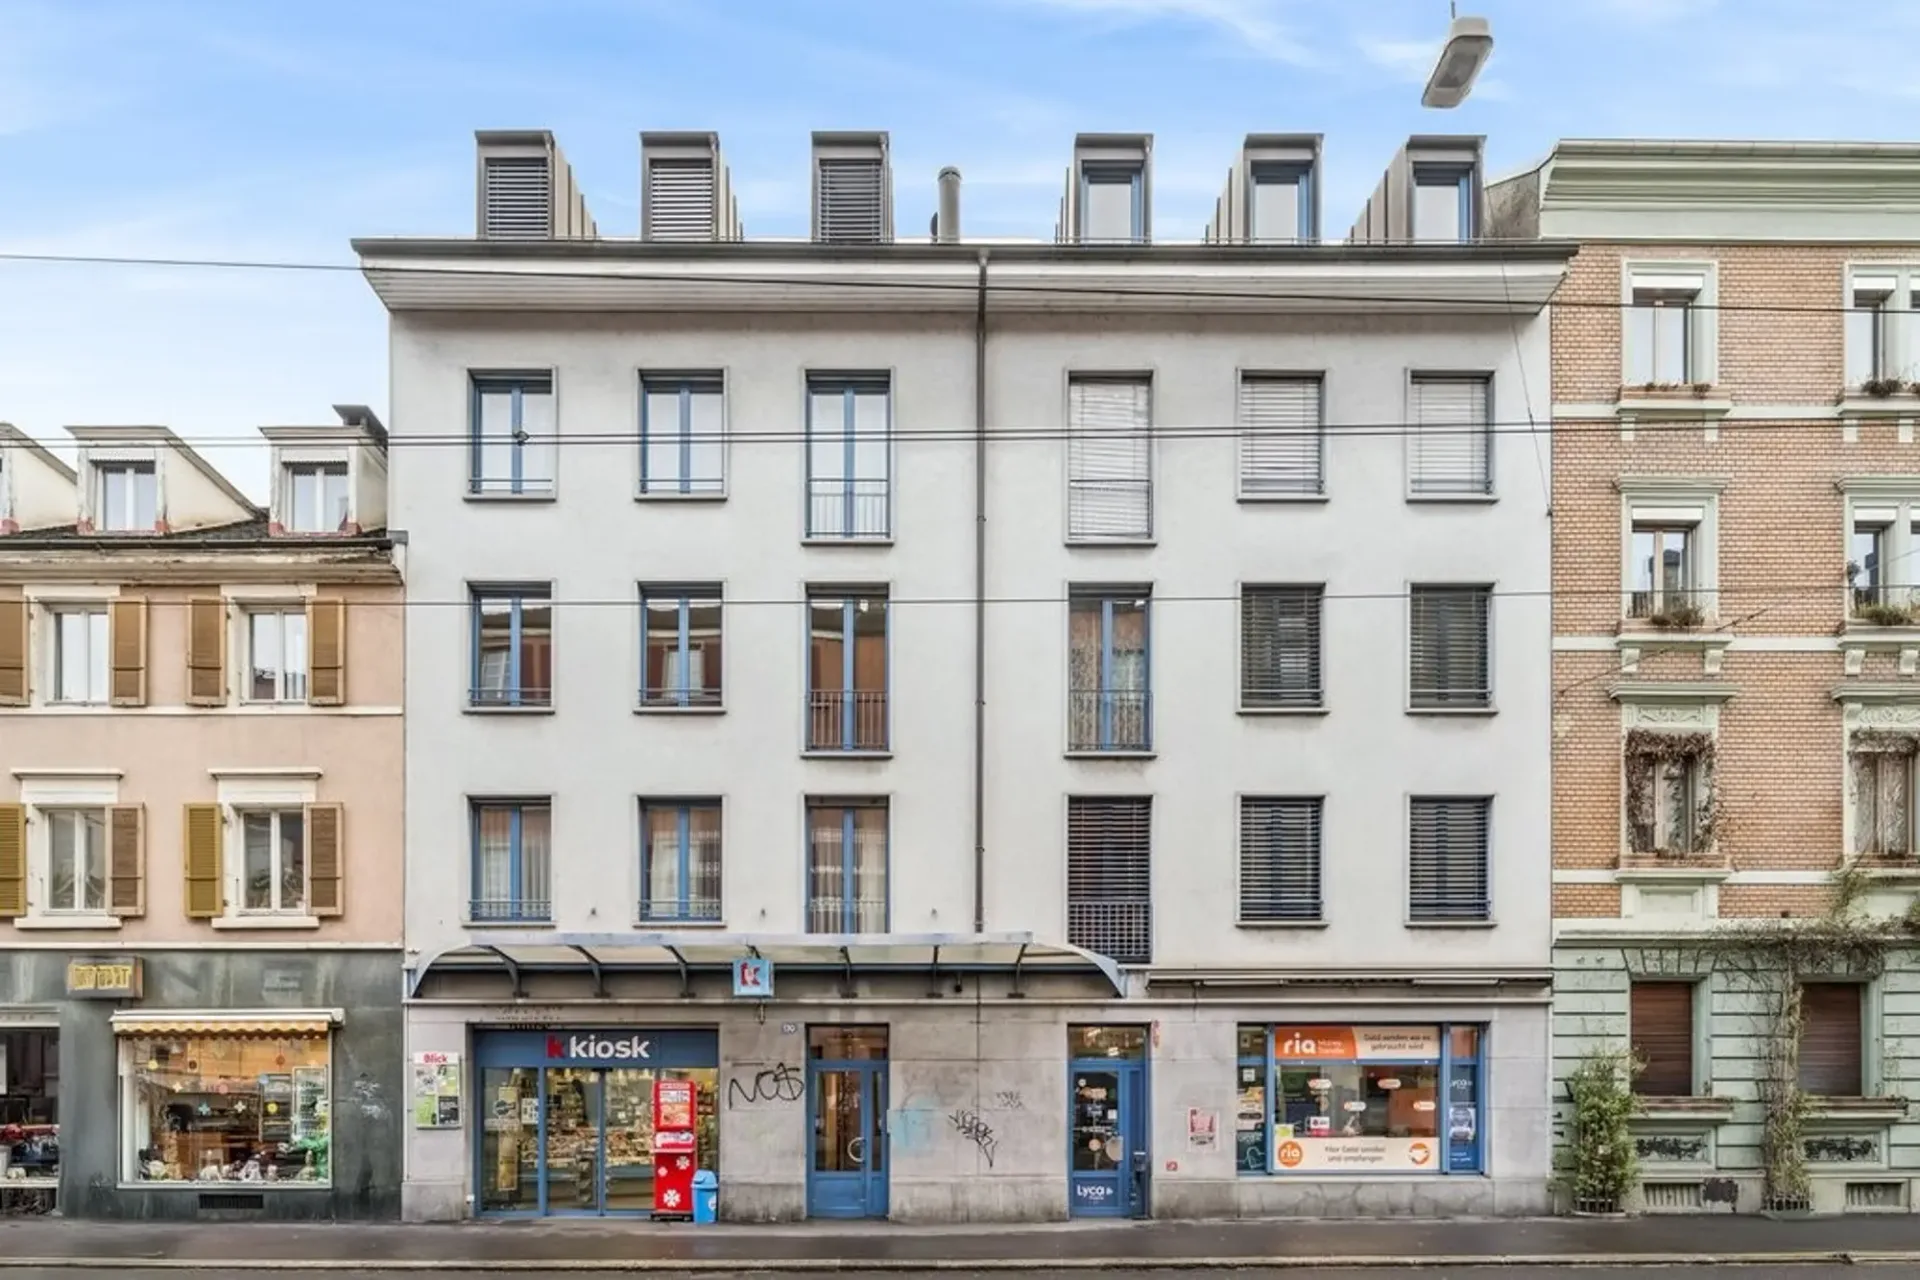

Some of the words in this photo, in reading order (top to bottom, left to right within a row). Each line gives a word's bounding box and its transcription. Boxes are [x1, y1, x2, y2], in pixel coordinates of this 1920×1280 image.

[569, 1034, 650, 1059] kiosk
[1283, 1032, 1316, 1054] ria
[423, 1053, 448, 1064] Blick
[1280, 1144, 1300, 1158] ria
[1076, 1184, 1105, 1198] Lyca
